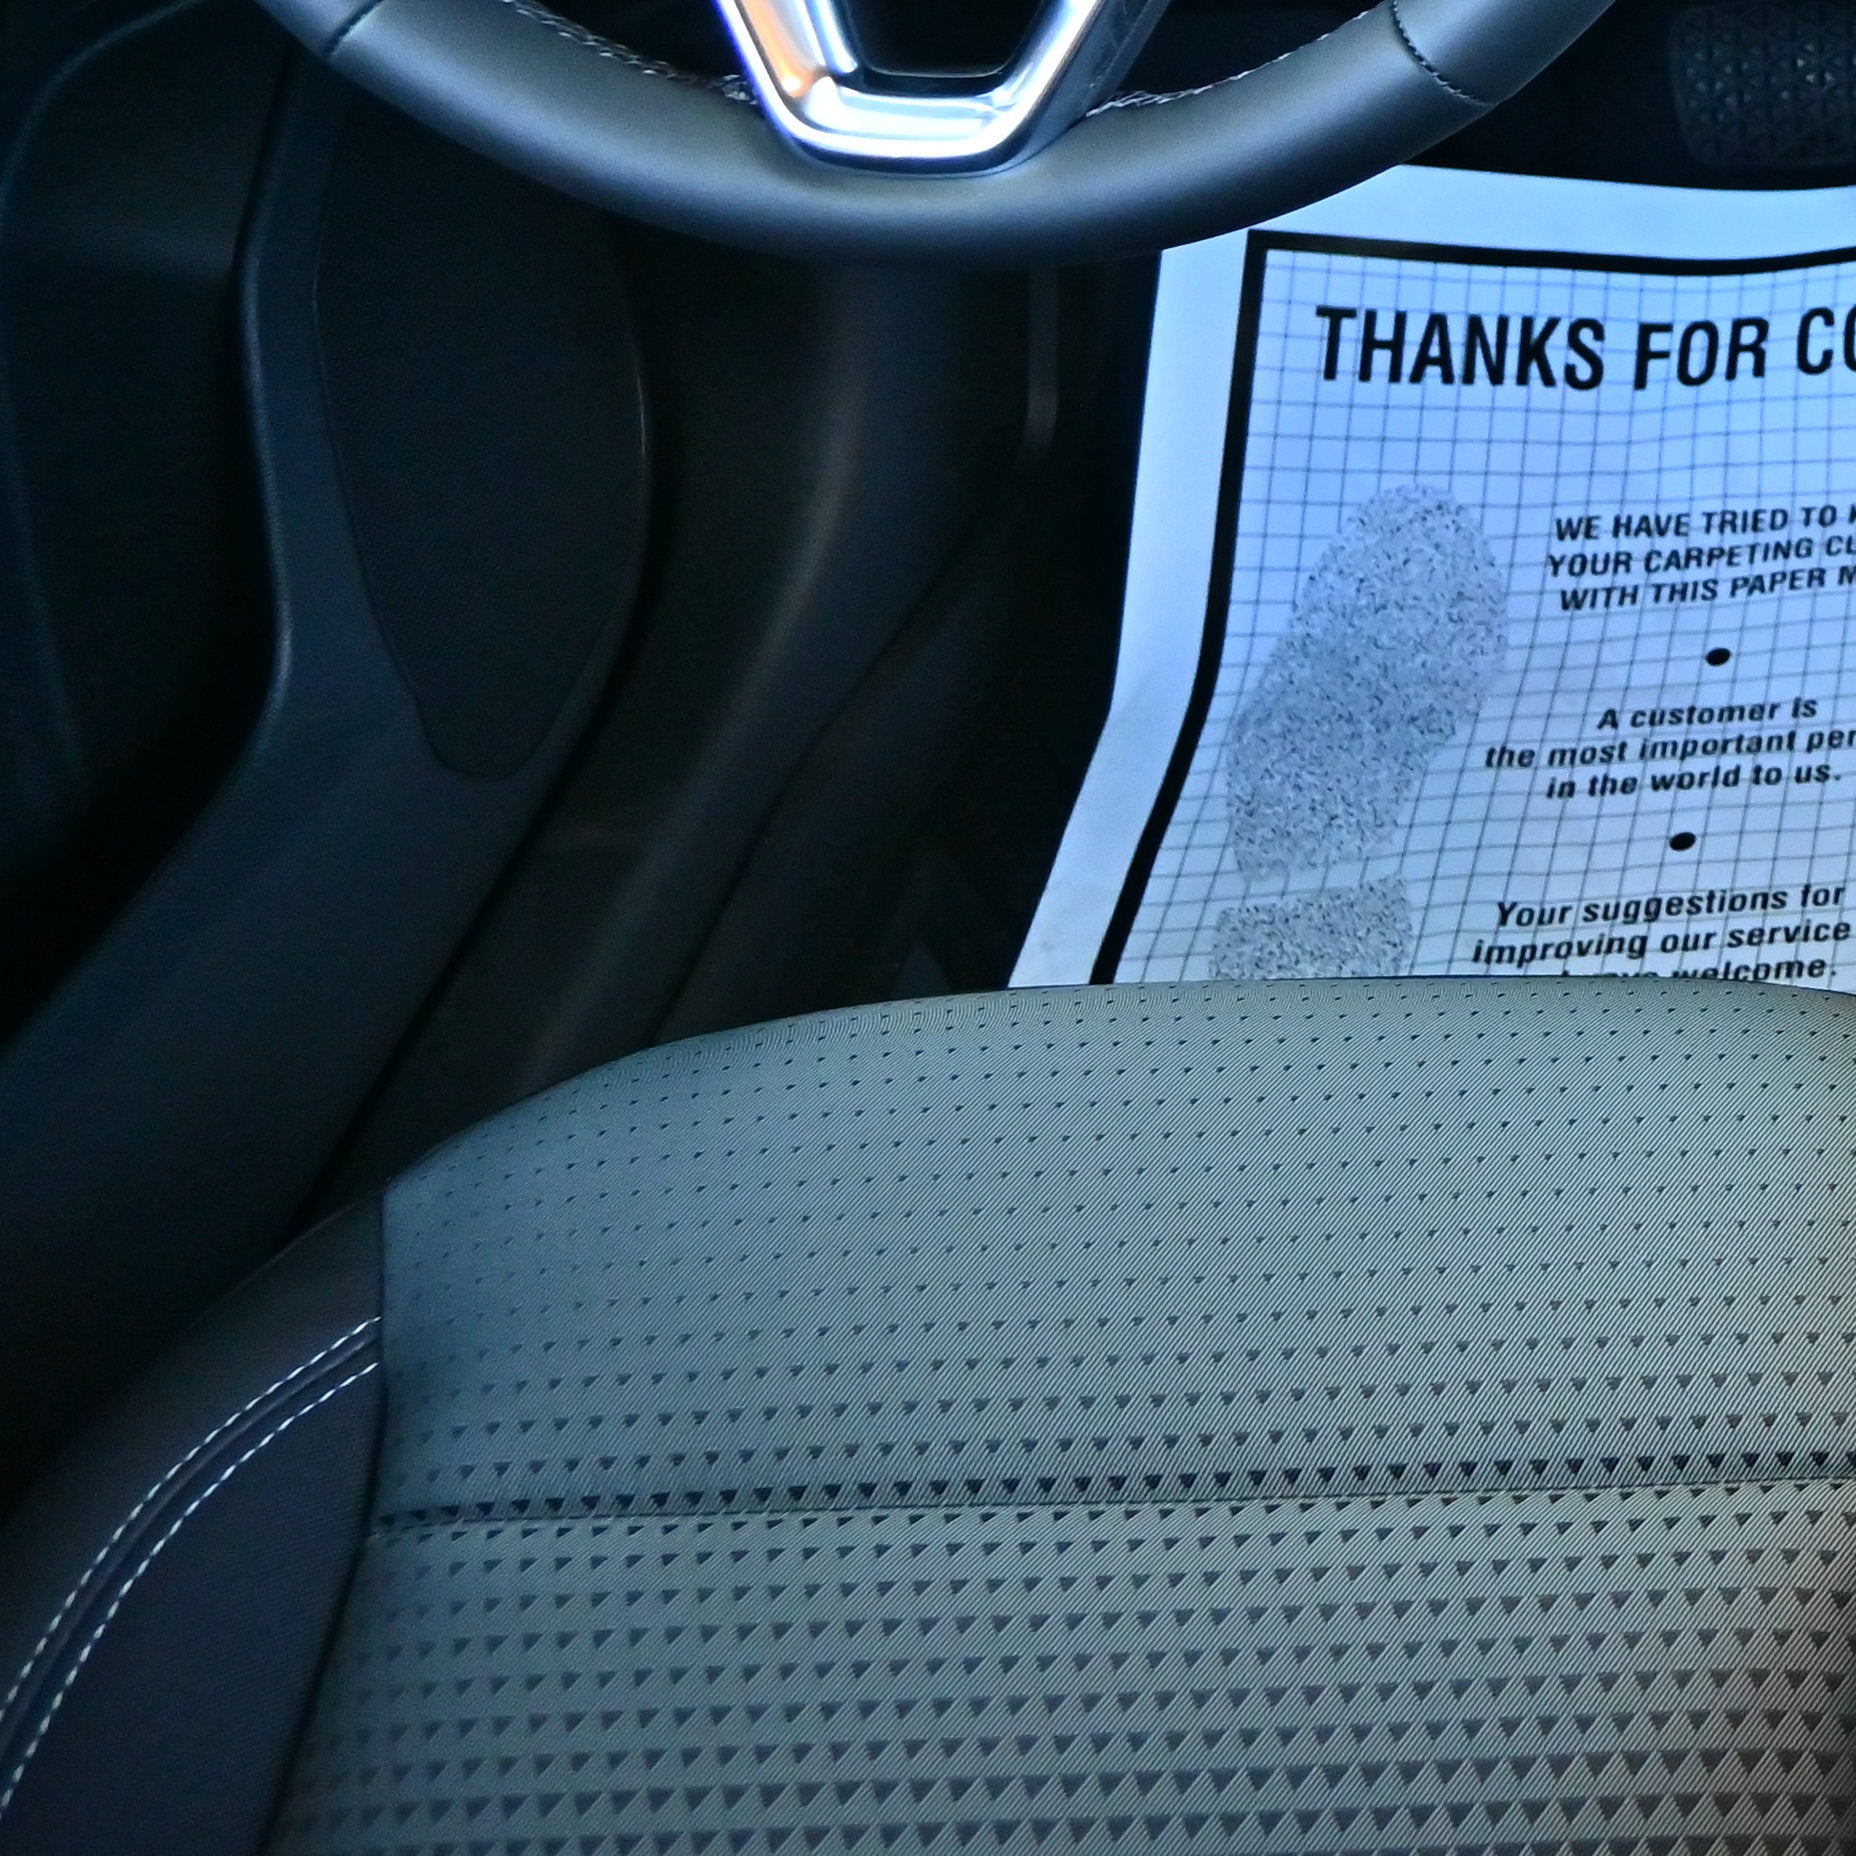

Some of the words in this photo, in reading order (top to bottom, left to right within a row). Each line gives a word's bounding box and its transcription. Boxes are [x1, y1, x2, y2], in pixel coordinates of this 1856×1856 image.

[1315, 305, 1603, 390] THANKS
[1633, 316, 1768, 390] FOR
[1555, 515, 1600, 542] WE
[1611, 513, 1691, 539] HAVE
[1702, 506, 1789, 535] TRIED
[1801, 504, 1838, 529] TO
[1547, 550, 1633, 578] YOUR
[1643, 537, 1813, 574] CARPETING
[1560, 585, 1638, 611] WITH
[1651, 578, 1719, 605] THIS
[1730, 569, 1826, 599] PAPER
[1597, 709, 1620, 731] A
[1629, 700, 1782, 730] customer
[1792, 698, 1817, 719] is
[1486, 745, 1536, 769] the
[1548, 741, 1627, 766] most
[1639, 728, 1797, 762] important
[1547, 776, 1576, 800] in
[1587, 772, 1638, 797] the
[1650, 765, 1740, 792] world
[1752, 765, 1781, 786] to
[1793, 762, 1842, 784] us.
[1497, 900, 1573, 927] Your
[1582, 887, 1787, 925] suggestions
[1800, 883, 1845, 907] for
[1472, 933, 1647, 968] improving
[1660, 930, 1716, 953] our
[1726, 919, 1851, 948] service
